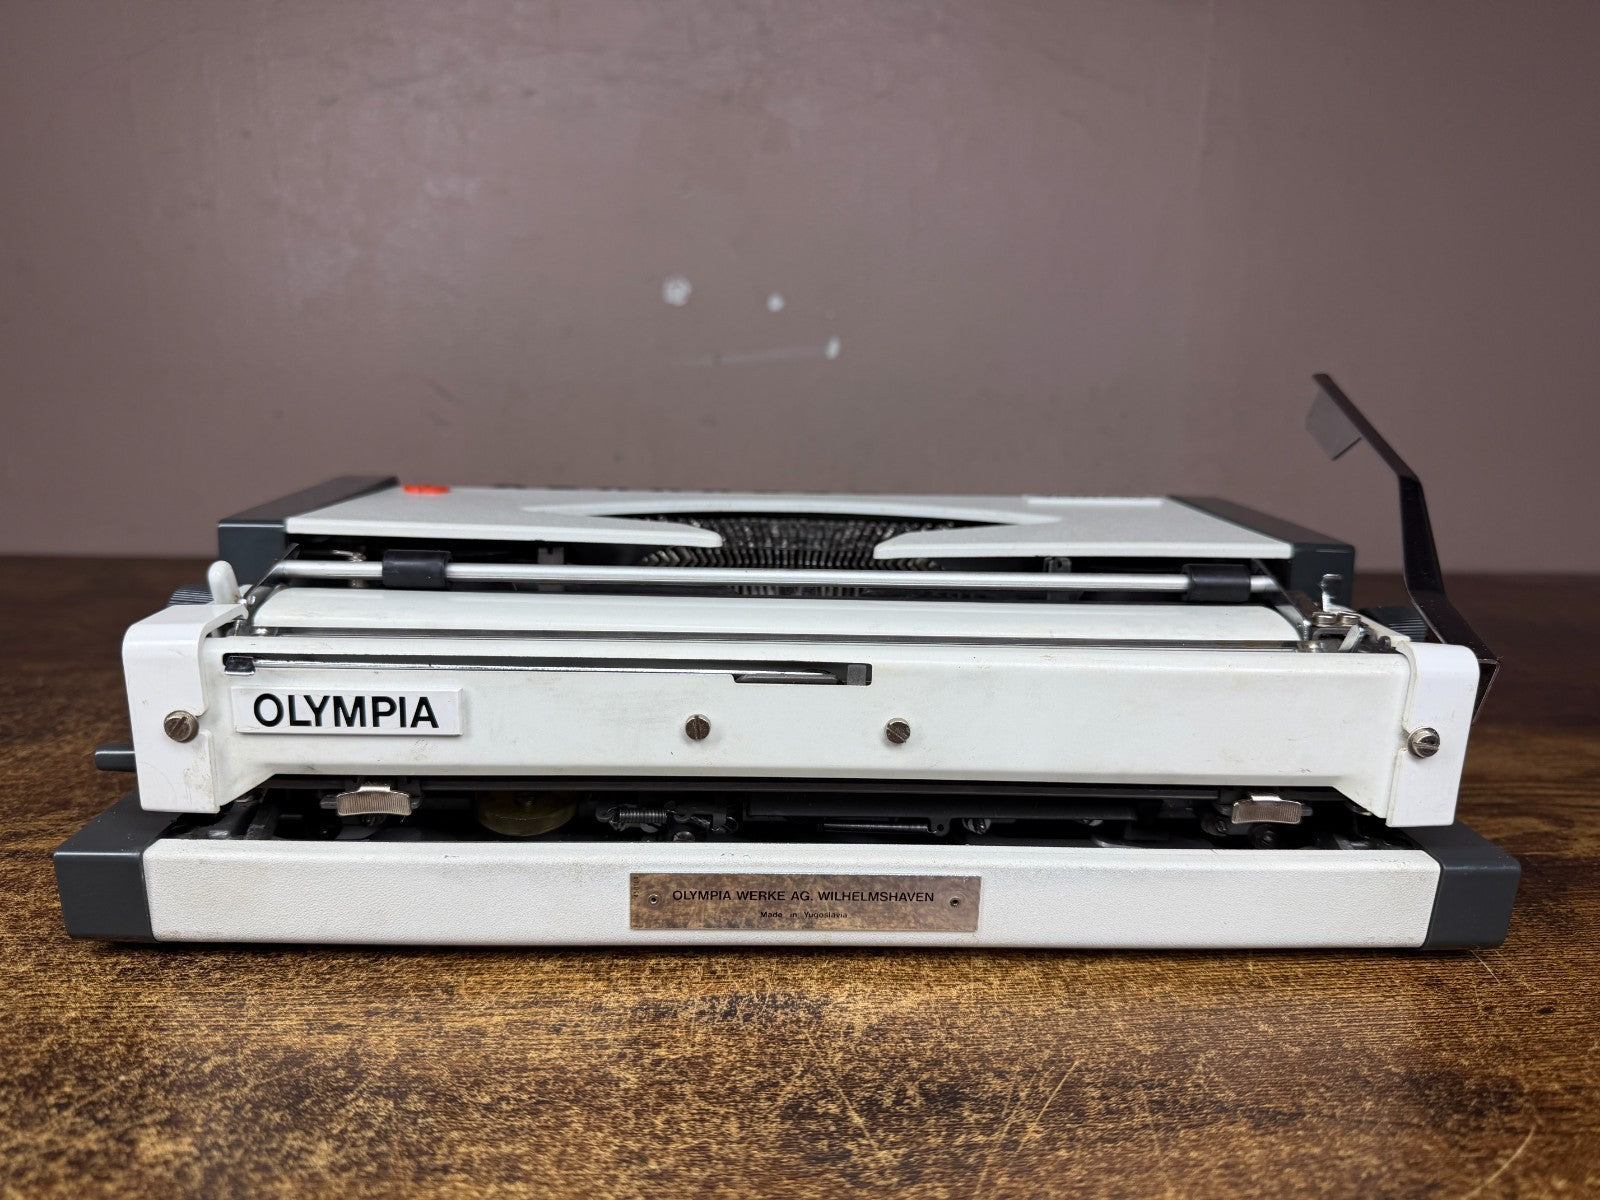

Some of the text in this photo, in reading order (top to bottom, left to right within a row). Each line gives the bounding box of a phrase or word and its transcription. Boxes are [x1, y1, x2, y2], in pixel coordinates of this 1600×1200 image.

[253, 692, 440, 729] OLYMPIA
[672, 890, 934, 902] OLYMPIA WERKE AG. WILHELMSHAVEN
[803, 911, 848, 919] Yugoslavia
